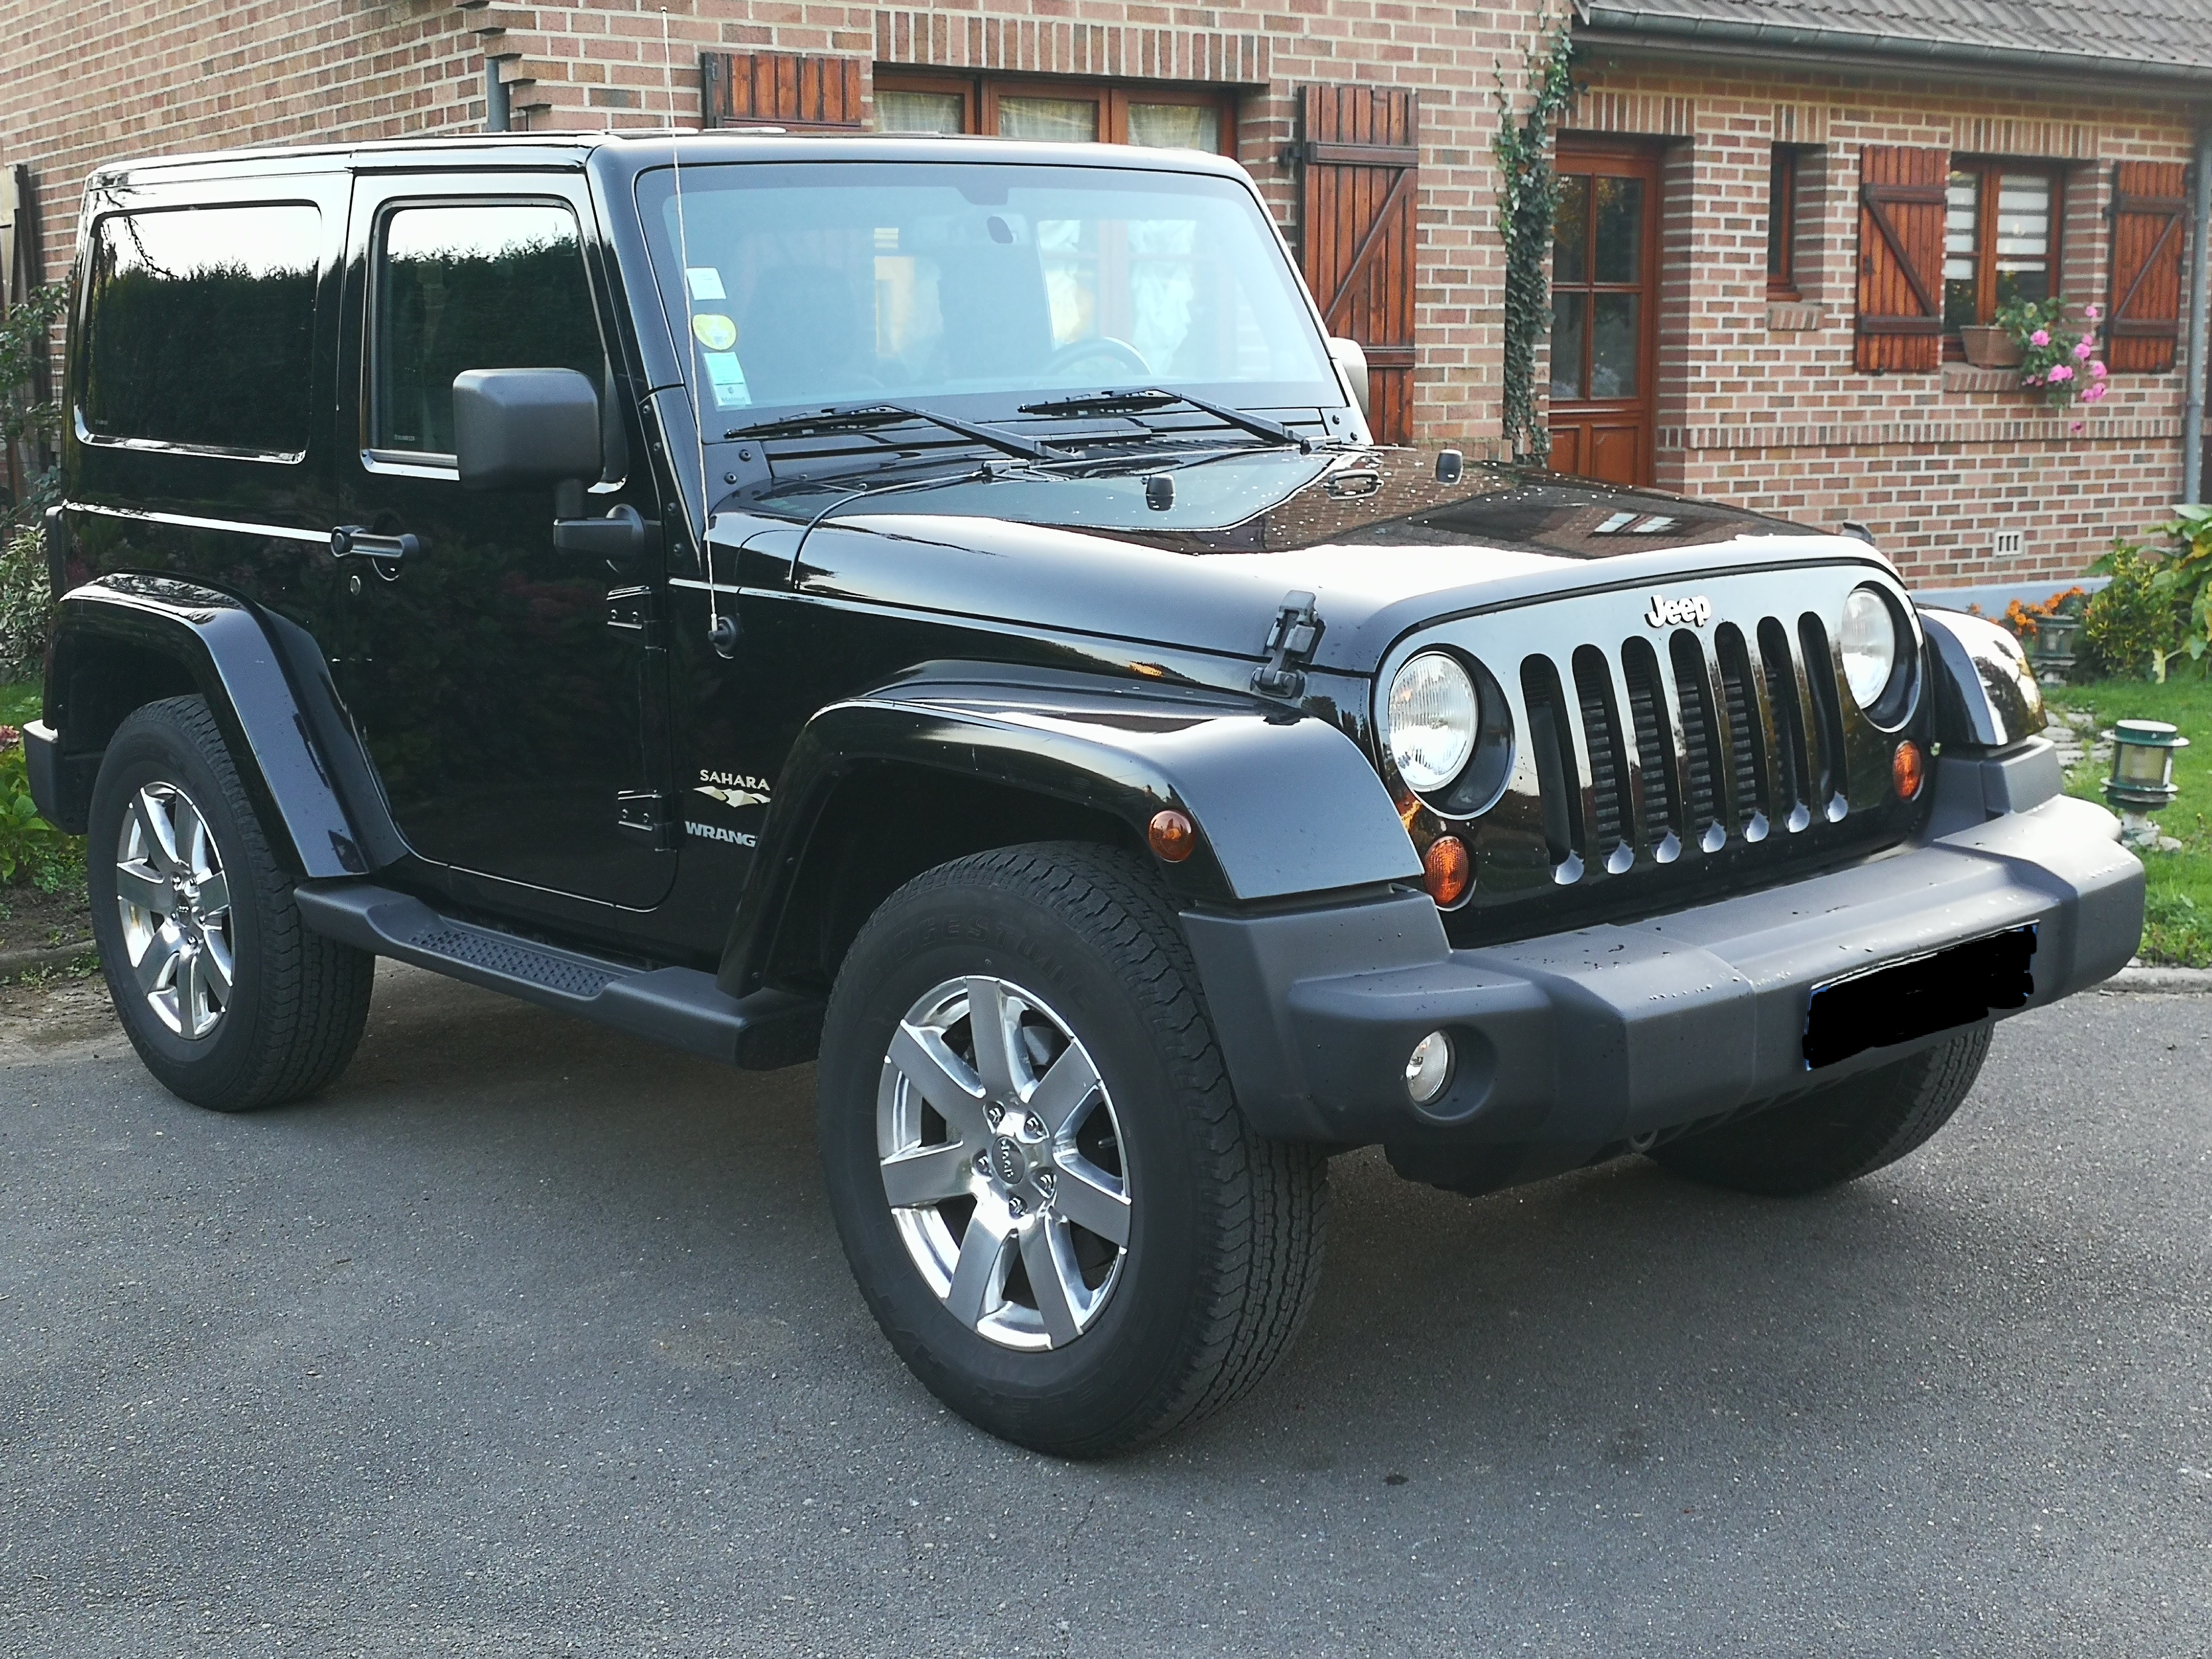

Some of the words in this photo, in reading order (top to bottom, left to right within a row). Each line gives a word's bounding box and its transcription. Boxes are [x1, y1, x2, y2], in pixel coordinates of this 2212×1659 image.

[1645, 594, 1711, 628] Jeep
[700, 769, 770, 790] SAHARA
[685, 821, 758, 847] WRANG
[844, 913, 1093, 1027] DGESTONE
